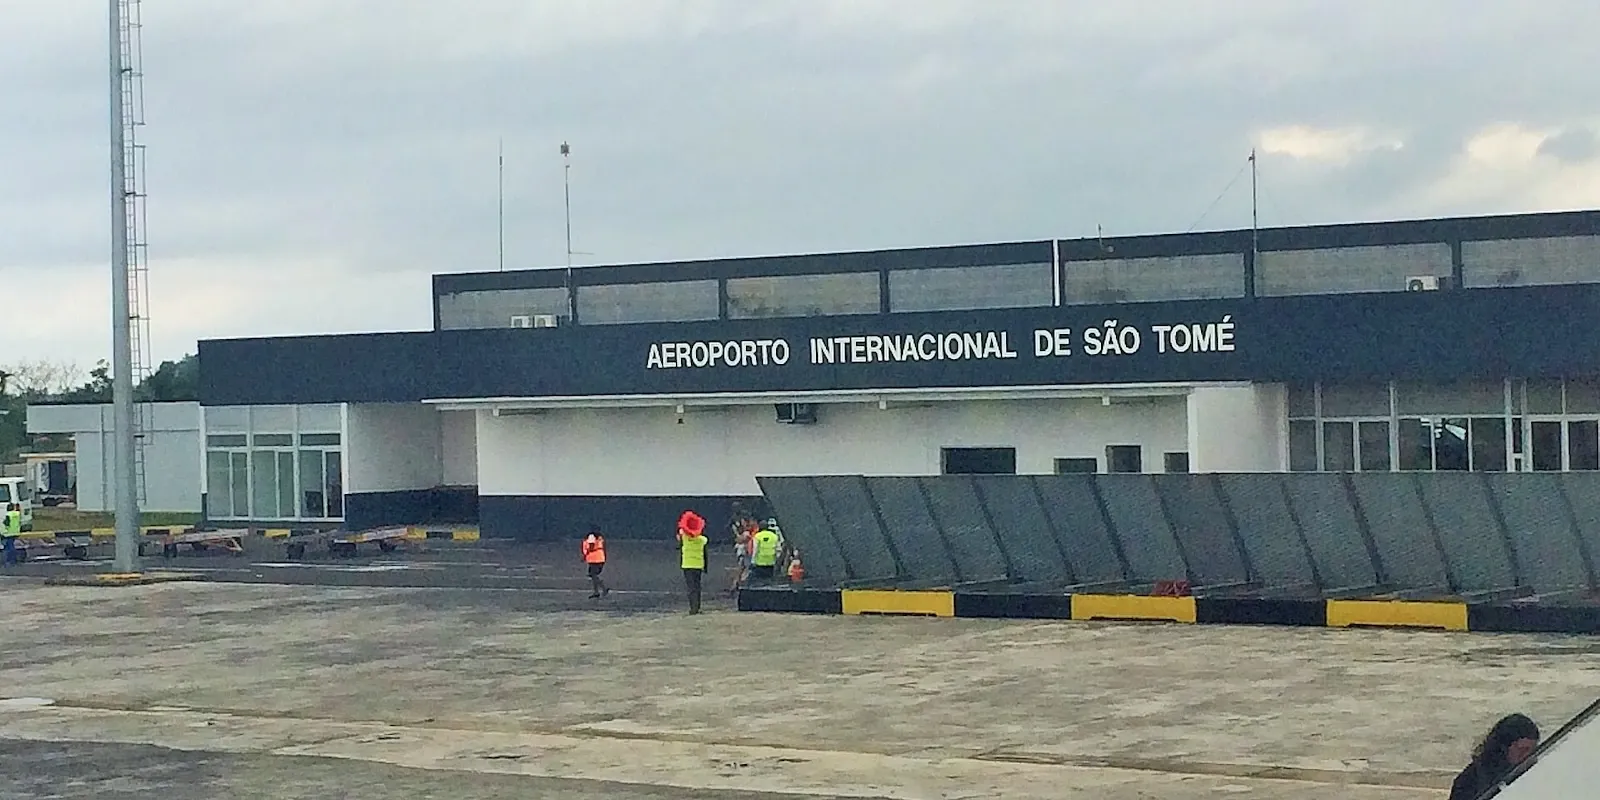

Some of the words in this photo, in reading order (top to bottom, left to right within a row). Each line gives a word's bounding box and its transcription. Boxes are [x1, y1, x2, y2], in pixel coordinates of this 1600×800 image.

[646, 339, 790, 369] AEROPORTO
[810, 331, 1017, 364] INTERNACIONAL
[1034, 328, 1071, 357] DE
[1084, 319, 1141, 355] SÃO
[1151, 315, 1235, 353] TOMÉ
